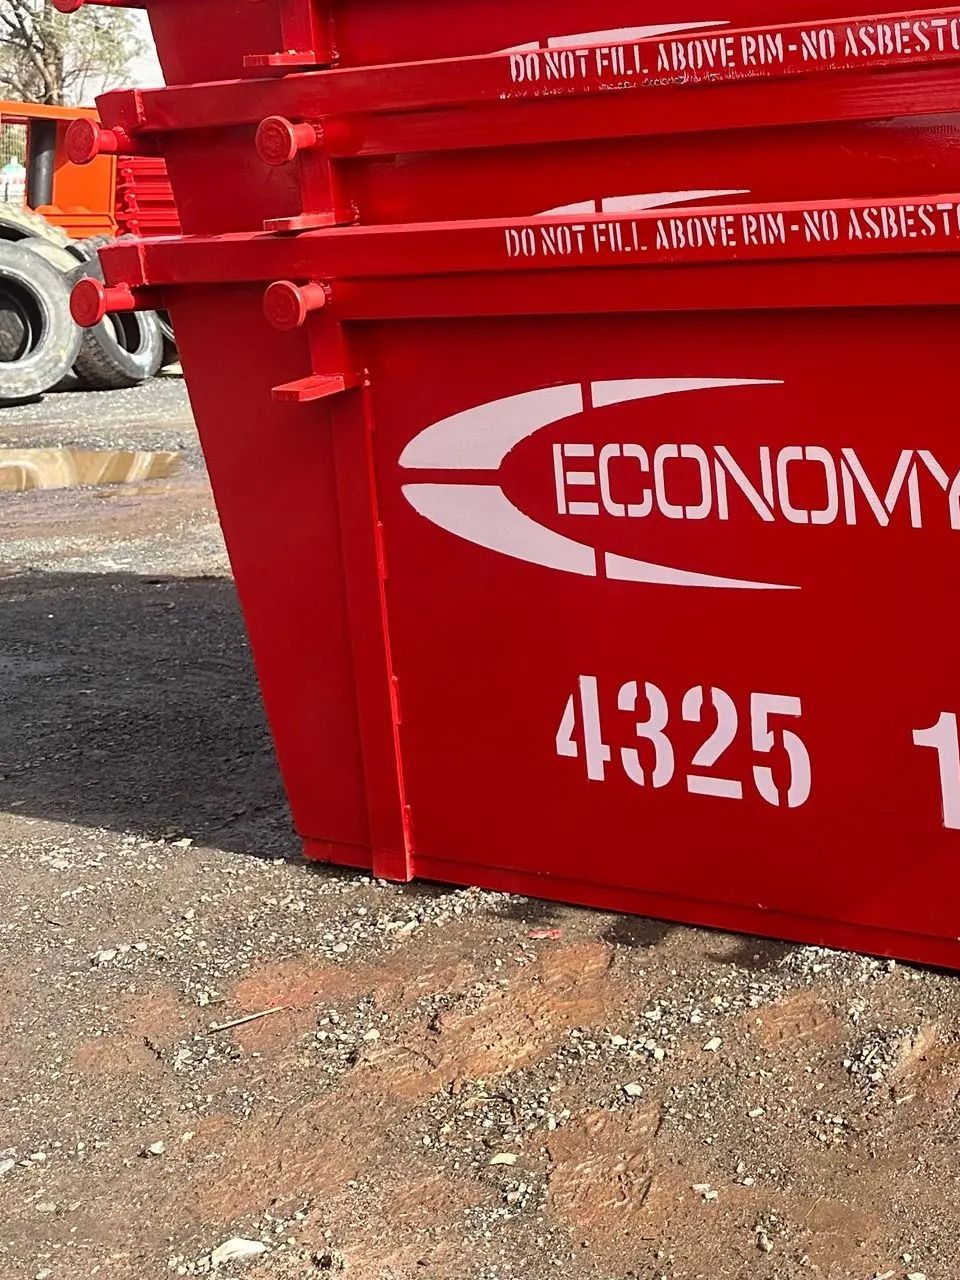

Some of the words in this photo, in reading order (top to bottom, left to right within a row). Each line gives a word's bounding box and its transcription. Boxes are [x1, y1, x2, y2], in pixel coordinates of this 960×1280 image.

[509, 52, 540, 82] DO
[545, 50, 588, 80] NOT
[595, 45, 649, 76] FILL
[656, 37, 736, 72] ABOVE
[505, 228, 536, 257] DO
[541, 224, 586, 256] NOT
[593, 221, 648, 252] FILL
[656, 215, 737, 250] ABOVE
[555, 674, 812, 808] 4325
